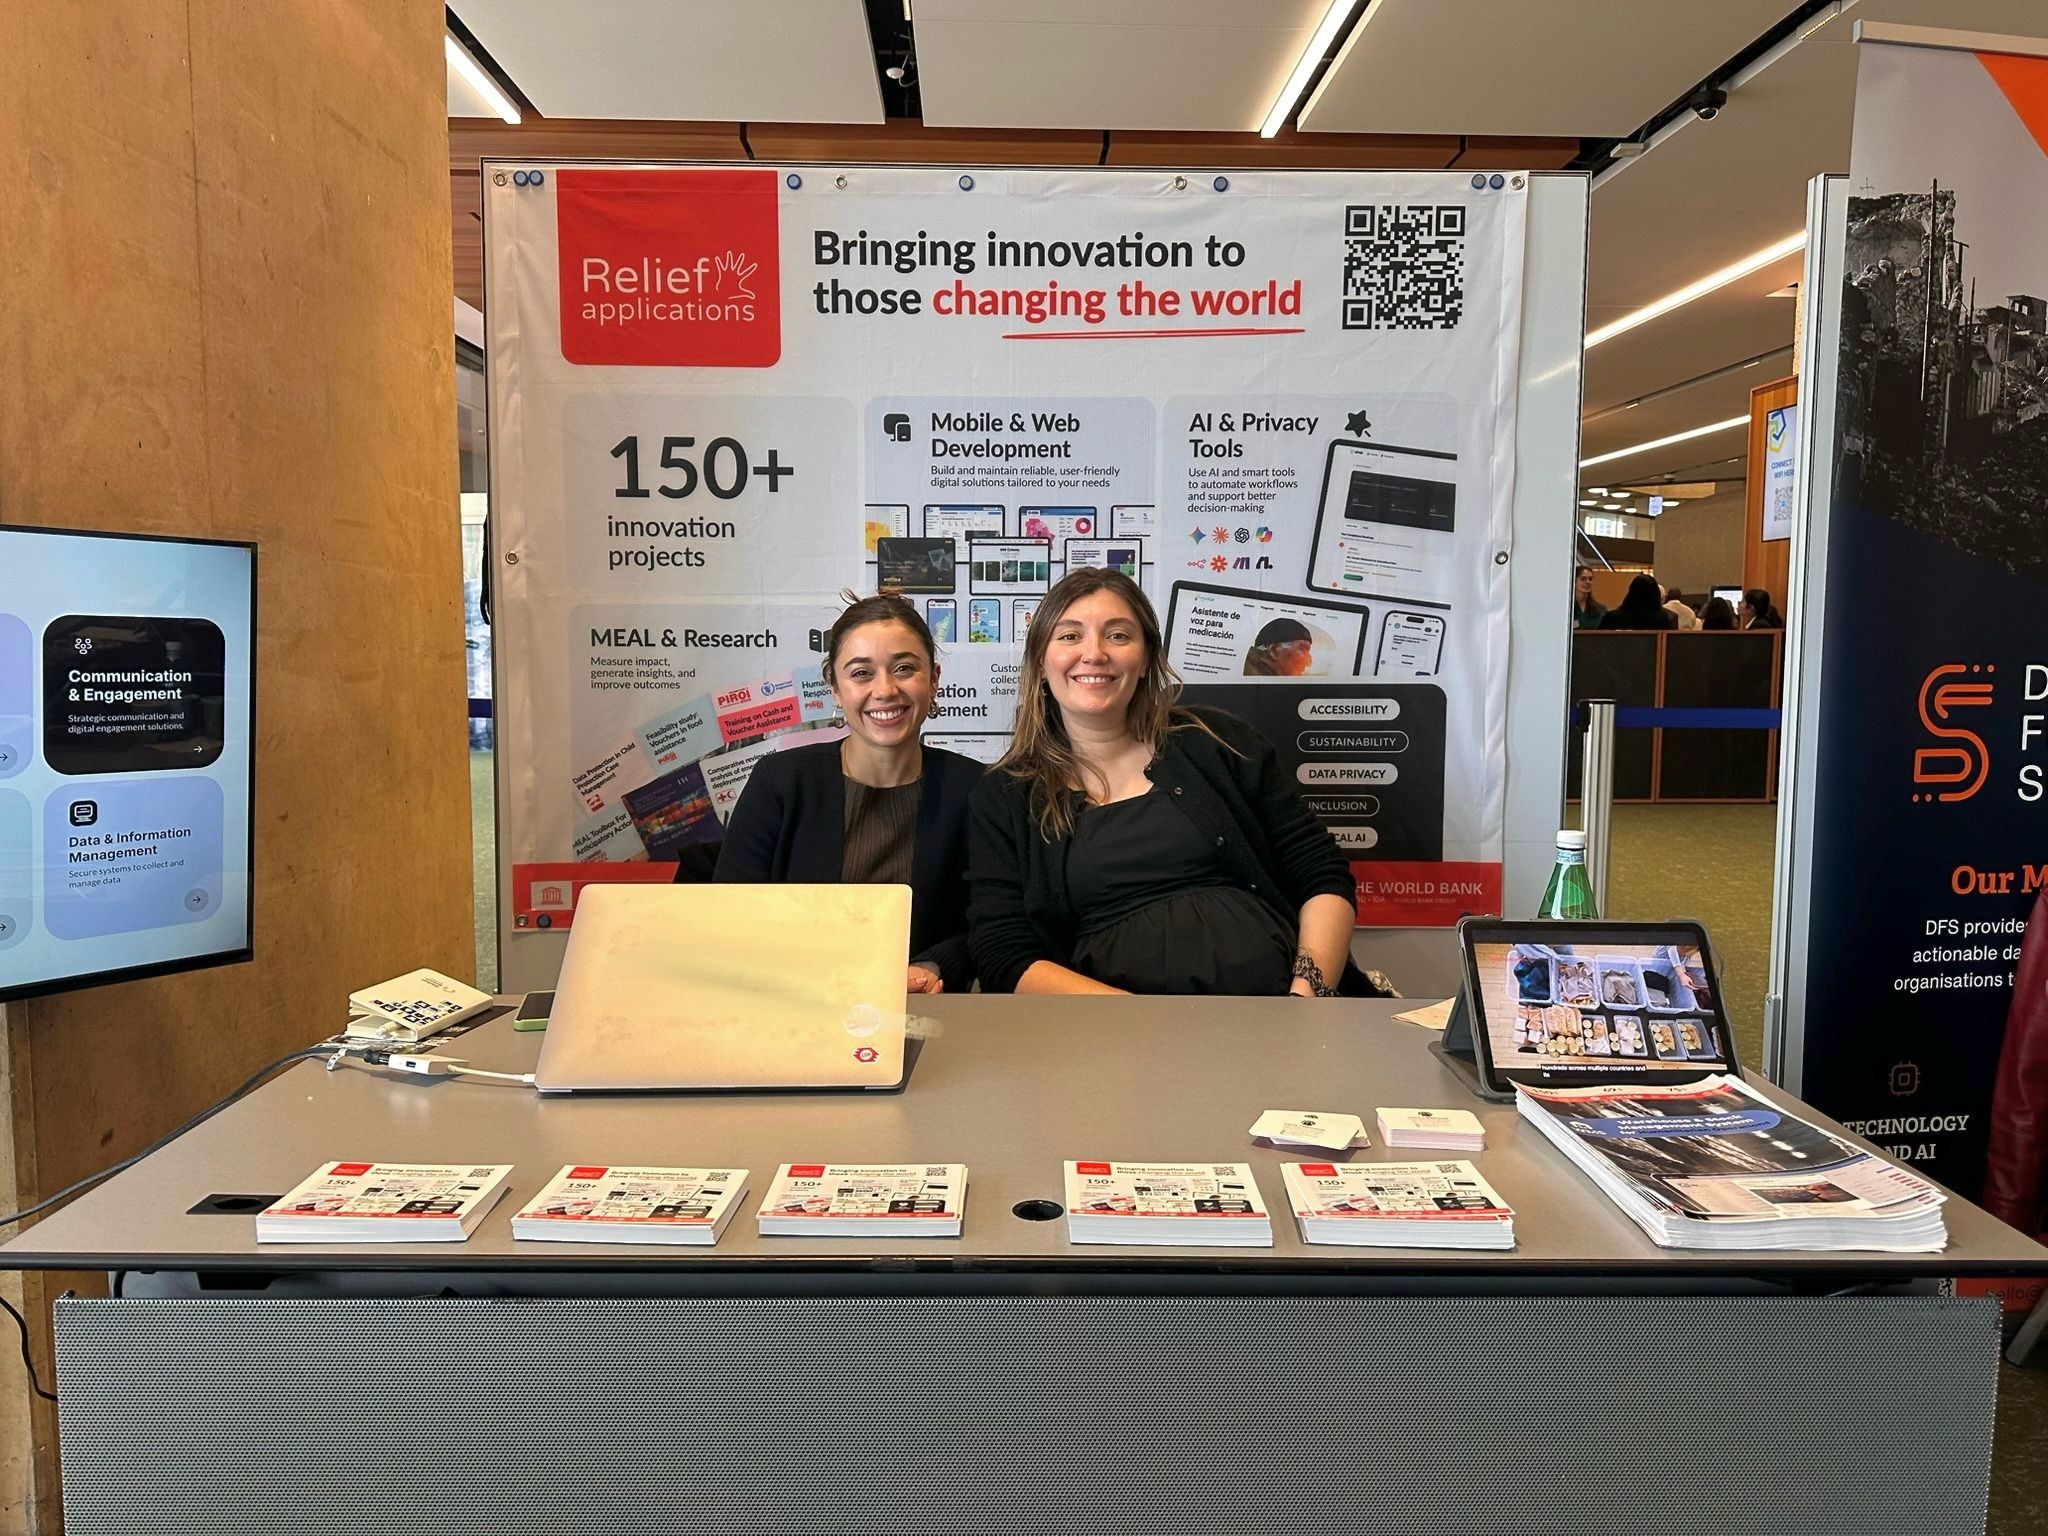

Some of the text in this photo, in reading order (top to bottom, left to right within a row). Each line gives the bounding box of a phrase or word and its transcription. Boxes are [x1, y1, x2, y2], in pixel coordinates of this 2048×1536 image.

[813, 230, 1246, 274] Bringing innovation to
[583, 257, 710, 293] Relief
[813, 278, 1301, 323] those changing the world
[582, 297, 756, 326] applications
[931, 412, 1081, 433] Mobile & Web
[1189, 412, 1320, 435] AI & Privacy
[931, 438, 1072, 462] Development
[1189, 438, 1244, 458] Tools
[610, 436, 795, 500] 150+
[931, 466, 1121, 478] Build and maintain reliable, user-friendly
[1189, 467, 1296, 477] Use AI and smart tools
[930, 477, 1110, 489] digital solutions tailored to your needs
[1188, 479, 1299, 489] to automate workflows
[1188, 491, 1277, 503] and support better
[1187, 503, 1266, 514] decision-making
[608, 515, 735, 538] innovation
[609, 545, 706, 571] projects
[1192, 606, 1229, 619] Asistente
[1230, 611, 1241, 620] de
[1190, 617, 1224, 628] voz para
[591, 628, 778, 648] MEAL & Research
[1188, 627, 1235, 640] medicación
[591, 656, 671, 668] Measure impact,
[69, 669, 192, 683] Communication
[590, 668, 696, 680] generate insights, and
[591, 680, 681, 691] improve outcomes
[803, 689, 832, 698] Respon
[937, 683, 977, 698] ation
[991, 686, 1016, 696] share
[69, 688, 183, 704] & Engagement
[68, 711, 184, 723] Strategic communication and
[724, 714, 752, 728] Training
[753, 713, 762, 721] on
[763, 707, 780, 718] Cash
[781, 704, 794, 713] and
[1310, 705, 1388, 715] ACCESSIBILITY
[68, 722, 184, 734] digital engagement solutions.
[645, 721, 678, 741] Feasibility
[649, 731, 681, 749] Vouchers
[689, 718, 704, 731] food
[727, 715, 792, 737] Voucher Assistance
[654, 737, 687, 756] assistance
[1309, 737, 1397, 747] SUSTAINABILITY
[707, 759, 745, 775] Comparative
[1309, 769, 1387, 779] DATA PRIVACY
[1309, 801, 1368, 811] INCLUSION
[615, 812, 627, 824] For
[69, 828, 192, 848] Data & Information
[1355, 832, 1367, 842] AI
[69, 845, 158, 863] Management
[69, 859, 184, 878] Secure systems to collect and
[69, 877, 121, 889] manage data
[1952, 866, 2015, 895] Our
[1357, 882, 1484, 896] HE WORLD BANK
[1926, 919, 1960, 936] DFS
[1913, 945, 2022, 963] actionable da
[1894, 972, 2003, 994] organisations
[1842, 1115, 1970, 1136] TECHNOLOGY
[1885, 1143, 1937, 1161] ND AI
